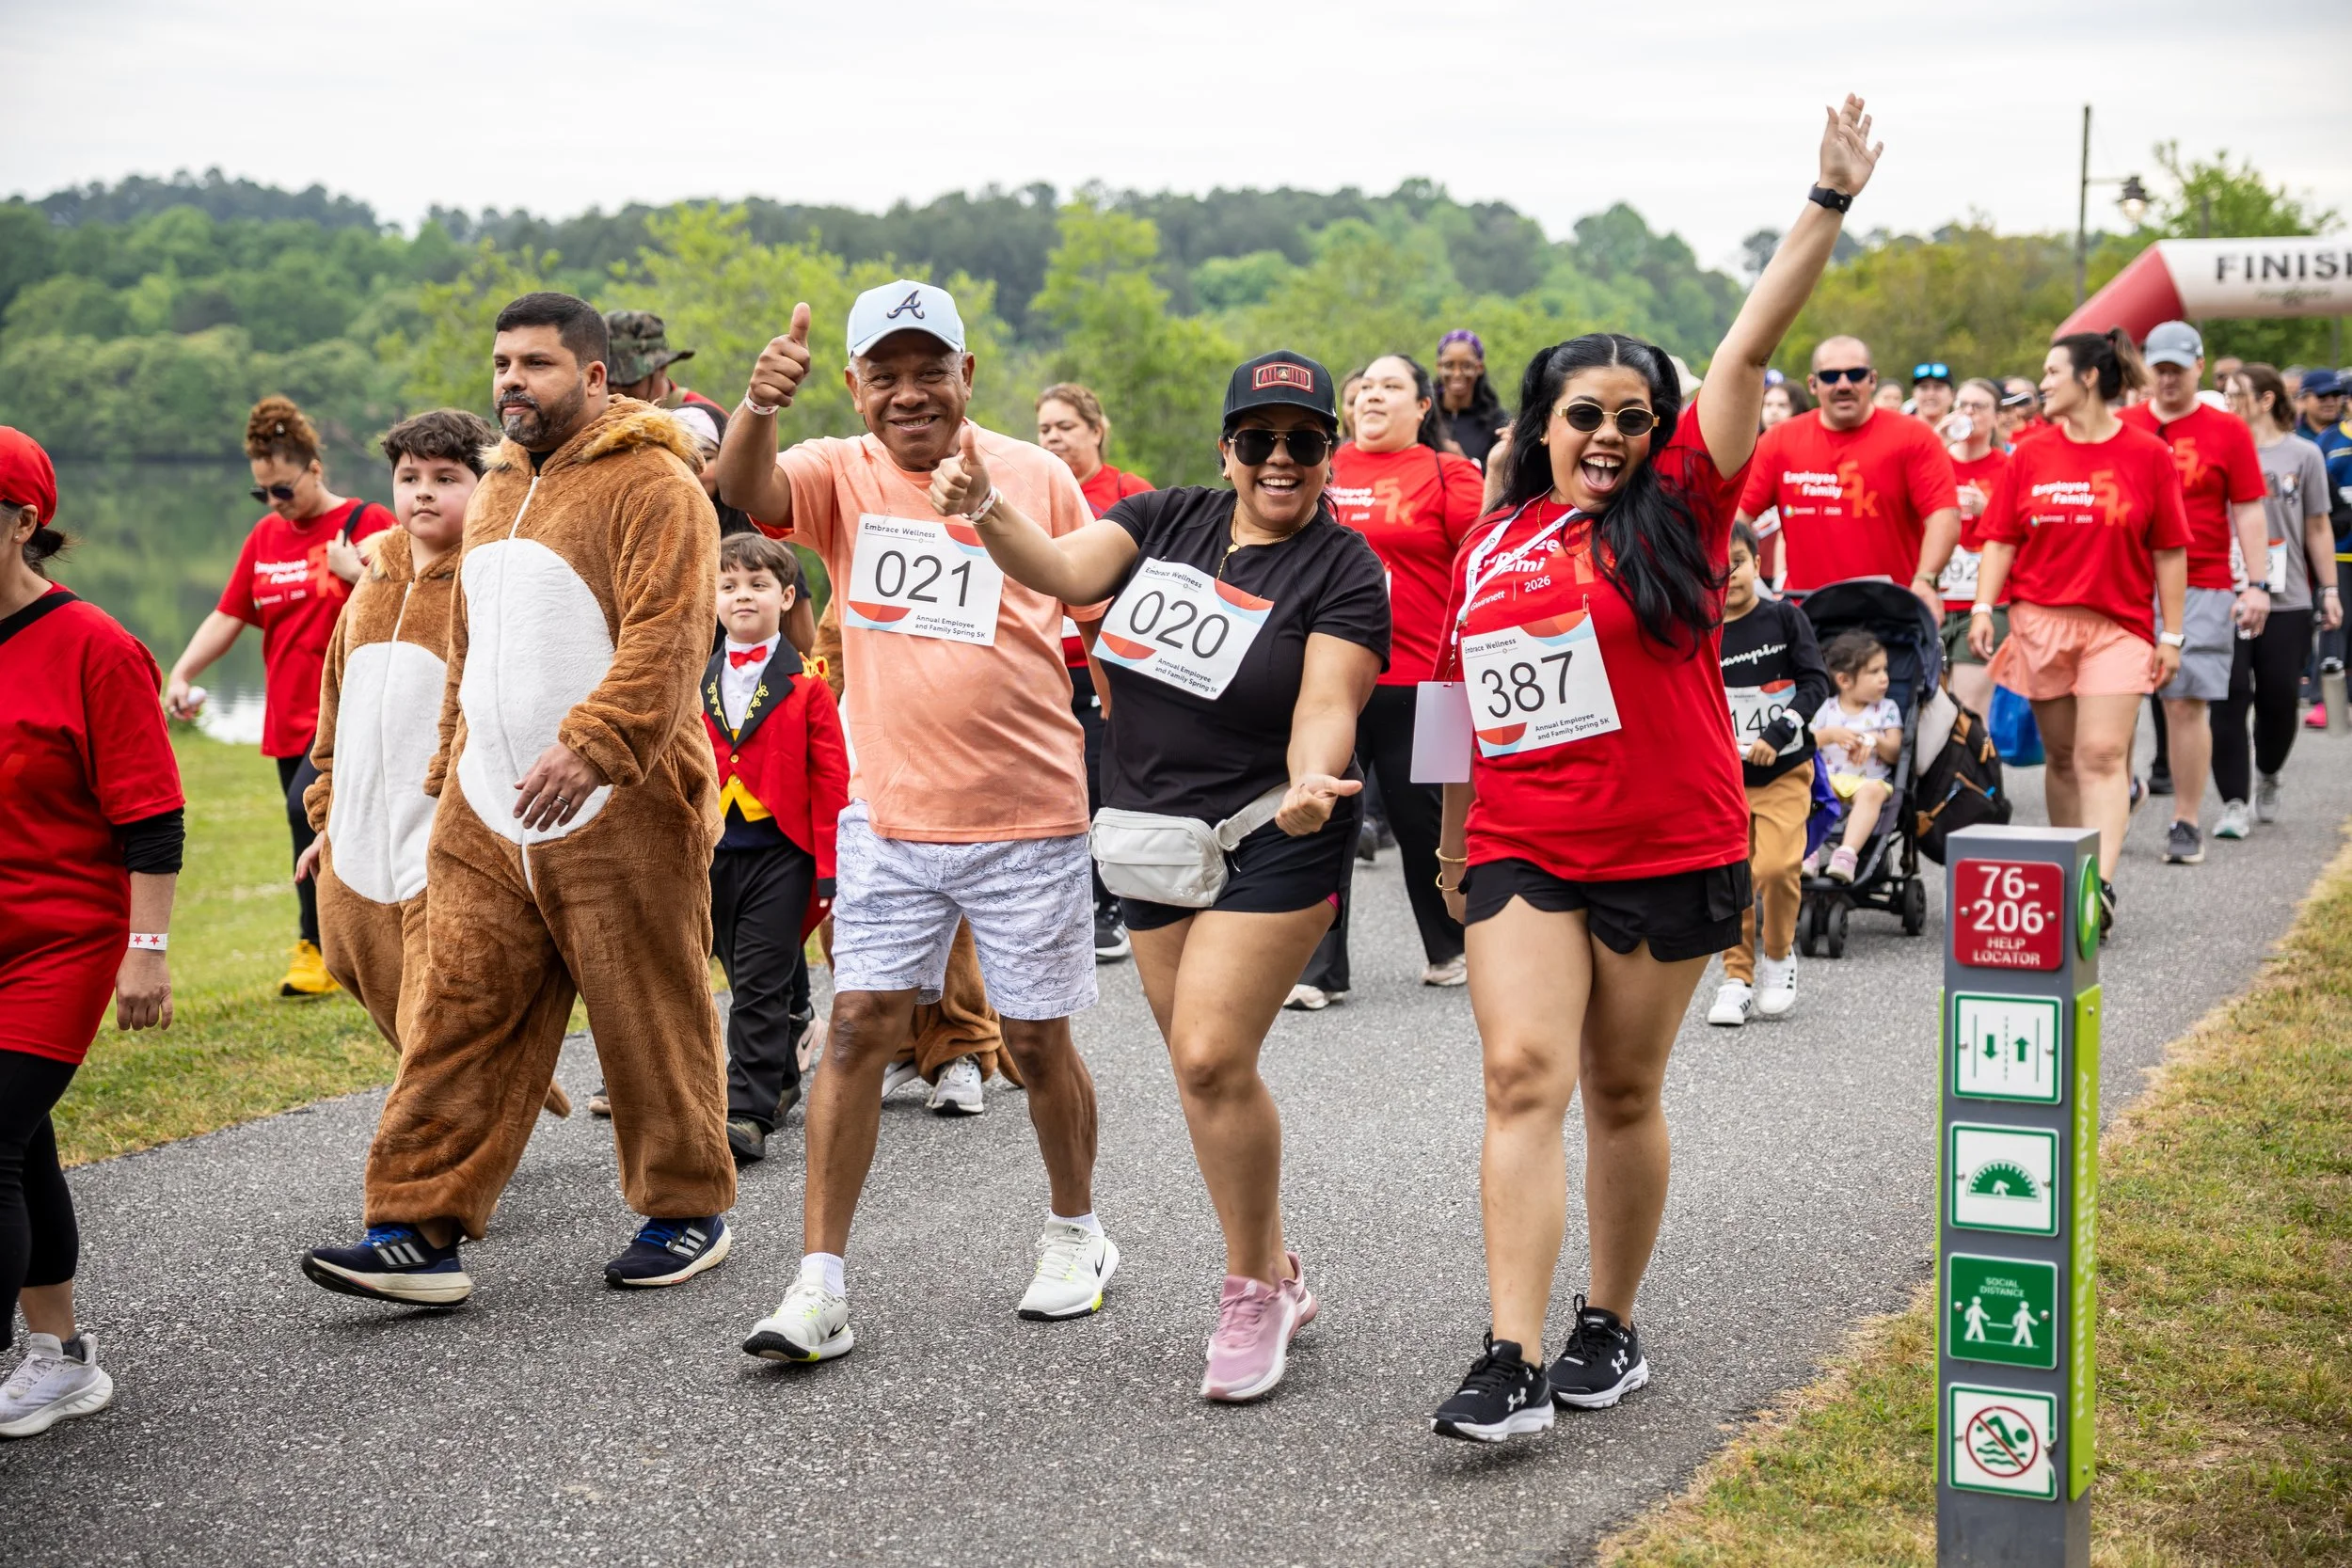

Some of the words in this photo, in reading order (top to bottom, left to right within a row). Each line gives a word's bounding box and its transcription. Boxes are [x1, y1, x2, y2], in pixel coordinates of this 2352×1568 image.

[2217, 252, 2352, 280] FINIS
[887, 290, 925, 319] A
[1783, 470, 1838, 485] Employee
[1802, 483, 1843, 500] Family
[2031, 481, 2090, 498] Employee
[2052, 492, 2096, 508] Family
[865, 523, 899, 534] Embrace
[902, 528, 936, 539] Wellness
[875, 550, 972, 608] 021
[1145, 566, 1170, 578] Embrace
[1171, 571, 1202, 589] Wellness
[1940, 557, 1980, 583] 92
[1470, 590, 1505, 611] Gwinnett
[1524, 575, 1551, 593] 2026
[916, 614, 941, 624] Annual
[942, 618, 975, 629] Employee
[929, 625, 951, 635] Family
[953, 627, 976, 639] Spring
[1130, 590, 1230, 659] 020
[1486, 637, 1517, 650] Wellness
[1154, 666, 1168, 675] and
[1167, 669, 1188, 684] Family
[1188, 677, 1210, 692] Spring
[1158, 657, 1181, 672] Annual
[1180, 665, 1212, 683] Employee
[1481, 650, 1573, 719] 387
[1534, 721, 1559, 733] Annual
[1560, 713, 1595, 726] Employee
[1537, 732, 1550, 740] and
[1550, 727, 1574, 738] Family
[1575, 721, 1599, 734] Spring
[1599, 717, 1610, 726] 5K
[1978, 865, 2040, 900] 76-
[1972, 898, 2044, 935] 206
[1986, 936, 2026, 950] HELP
[1972, 949, 2041, 966] LOCATOR
[2077, 1070, 2090, 1275] GREENWAY
[2086, 1184, 2096, 1291] TRAIL
[1979, 1285, 2025, 1298] DISTANCE
[1985, 1276, 2019, 1289] SOCIAL
[2075, 1284, 2086, 1420] HARRIS
